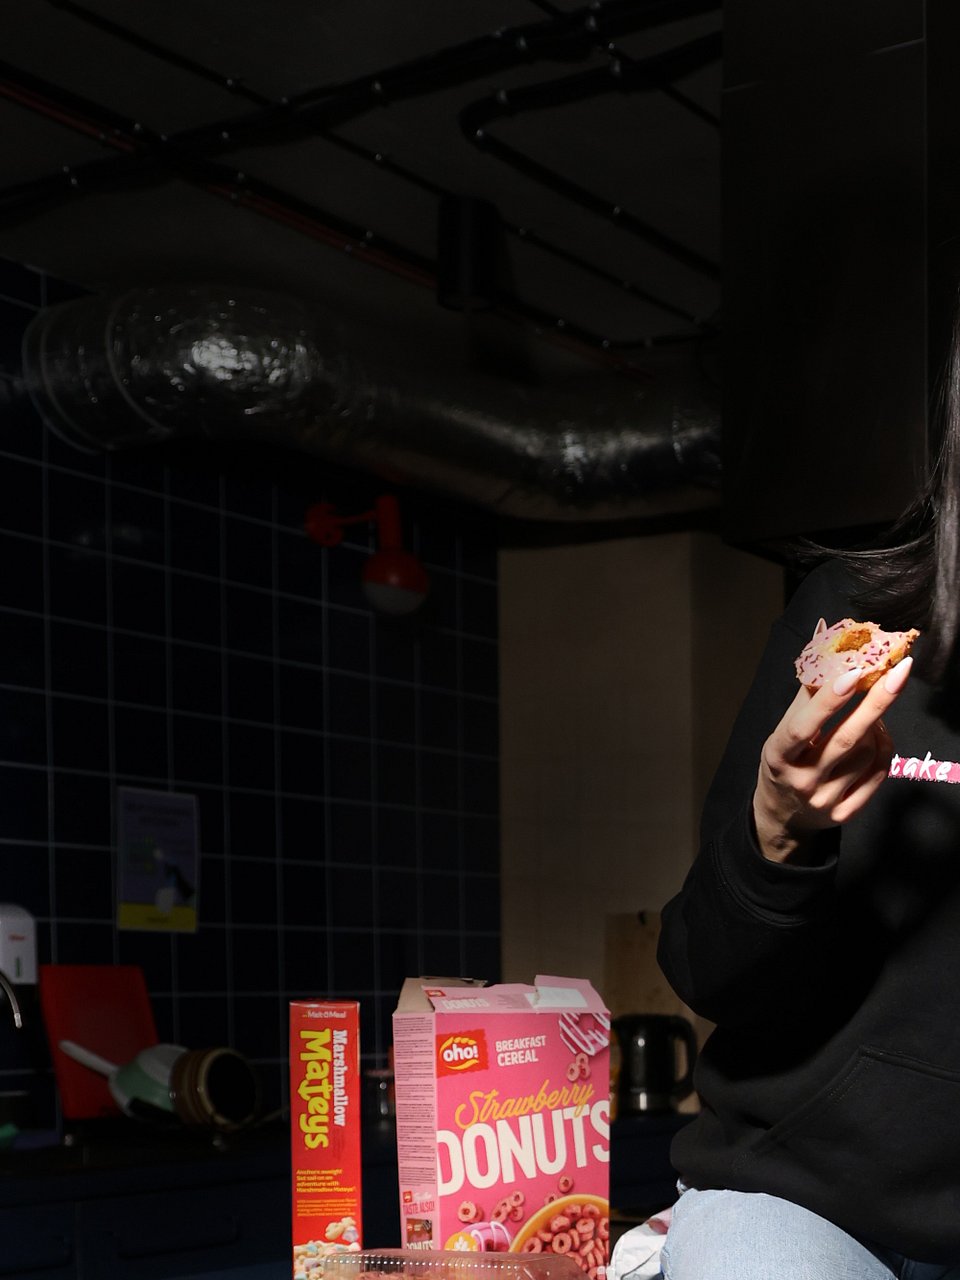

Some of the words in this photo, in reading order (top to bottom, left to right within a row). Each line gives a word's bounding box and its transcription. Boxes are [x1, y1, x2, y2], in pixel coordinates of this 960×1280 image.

[890, 751, 953, 781] take
[443, 1044, 479, 1062] oho!
[496, 1035, 547, 1053] BREAKFAST
[497, 1050, 539, 1067] CEREAL
[297, 1028, 334, 1150] Mateys
[333, 1029, 349, 1127] Marshmallow
[455, 1079, 595, 1130] Strawberry
[436, 1099, 610, 1197] DONUTS
